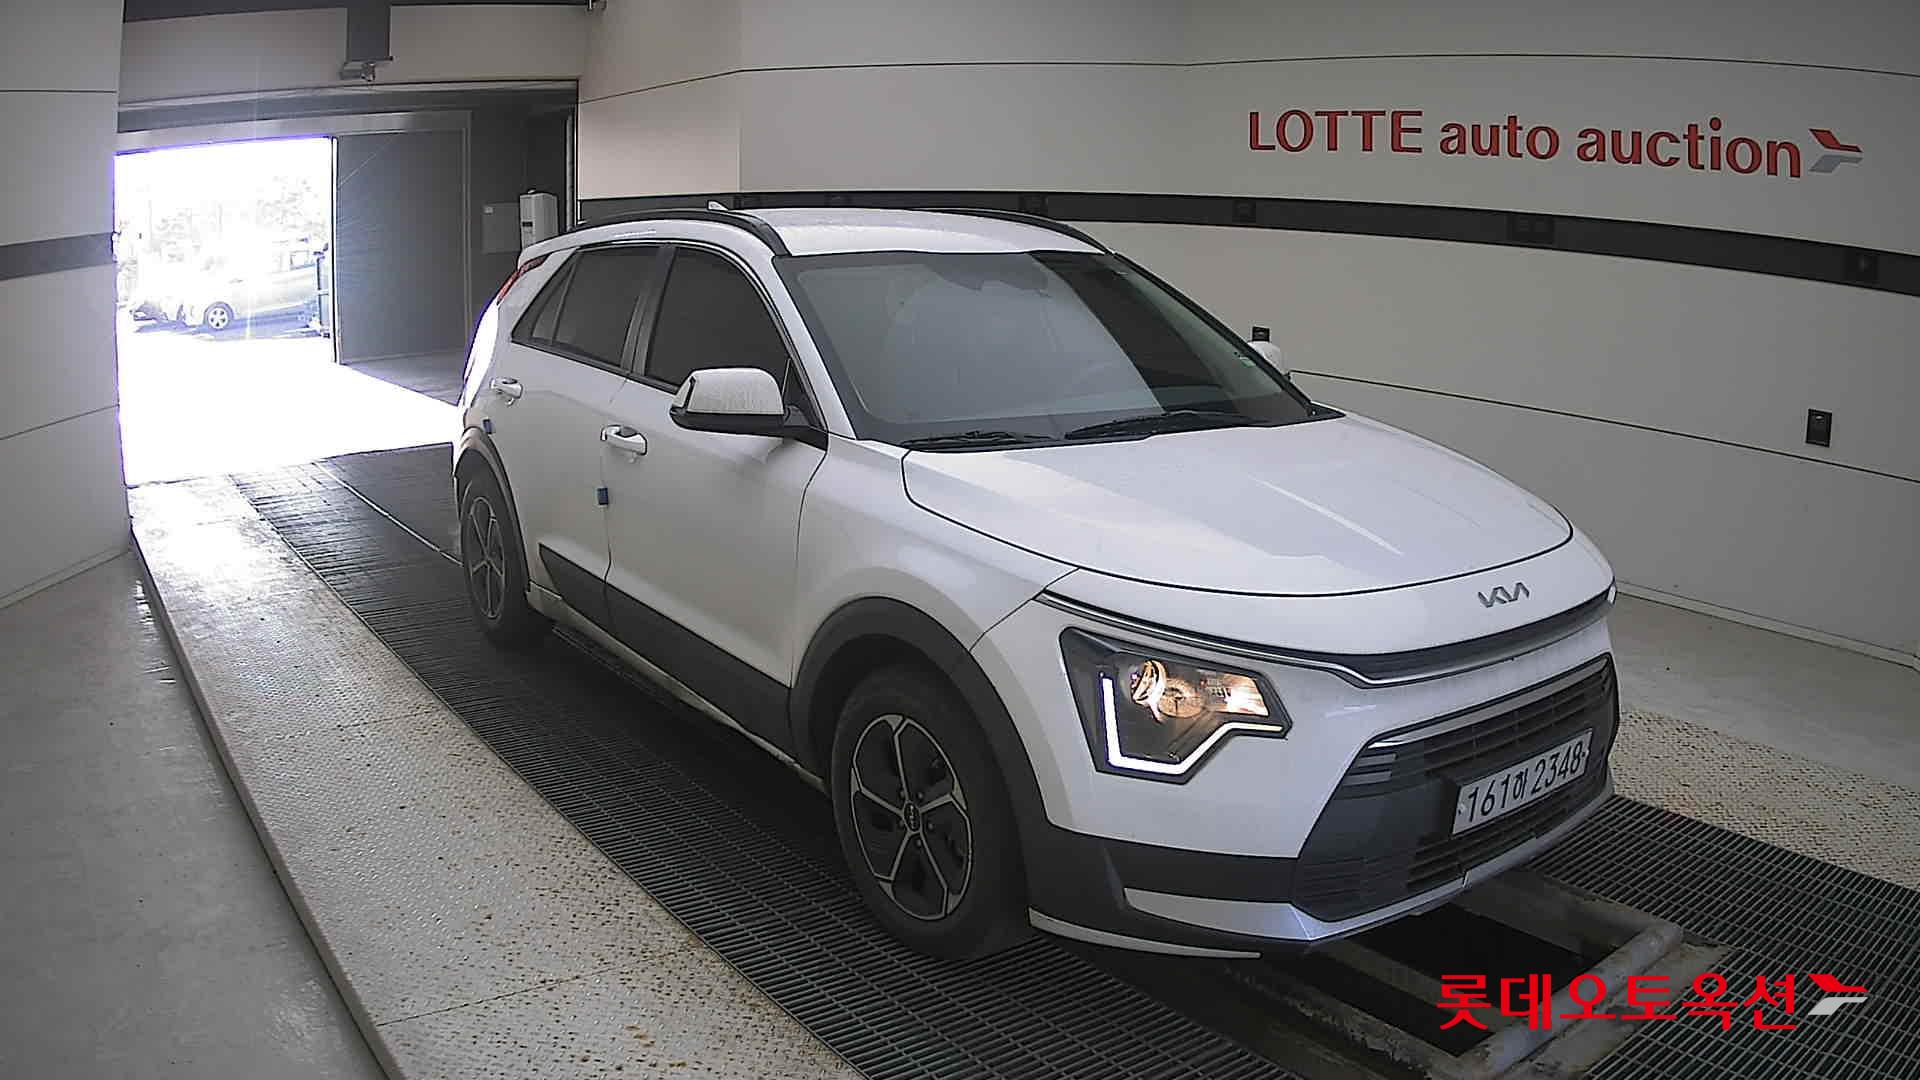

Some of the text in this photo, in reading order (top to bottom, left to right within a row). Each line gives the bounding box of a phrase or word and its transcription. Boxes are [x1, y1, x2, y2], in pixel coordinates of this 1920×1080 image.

[1249, 110, 1801, 178] LOTTE auto auction
[1531, 741, 1584, 795] 2348
